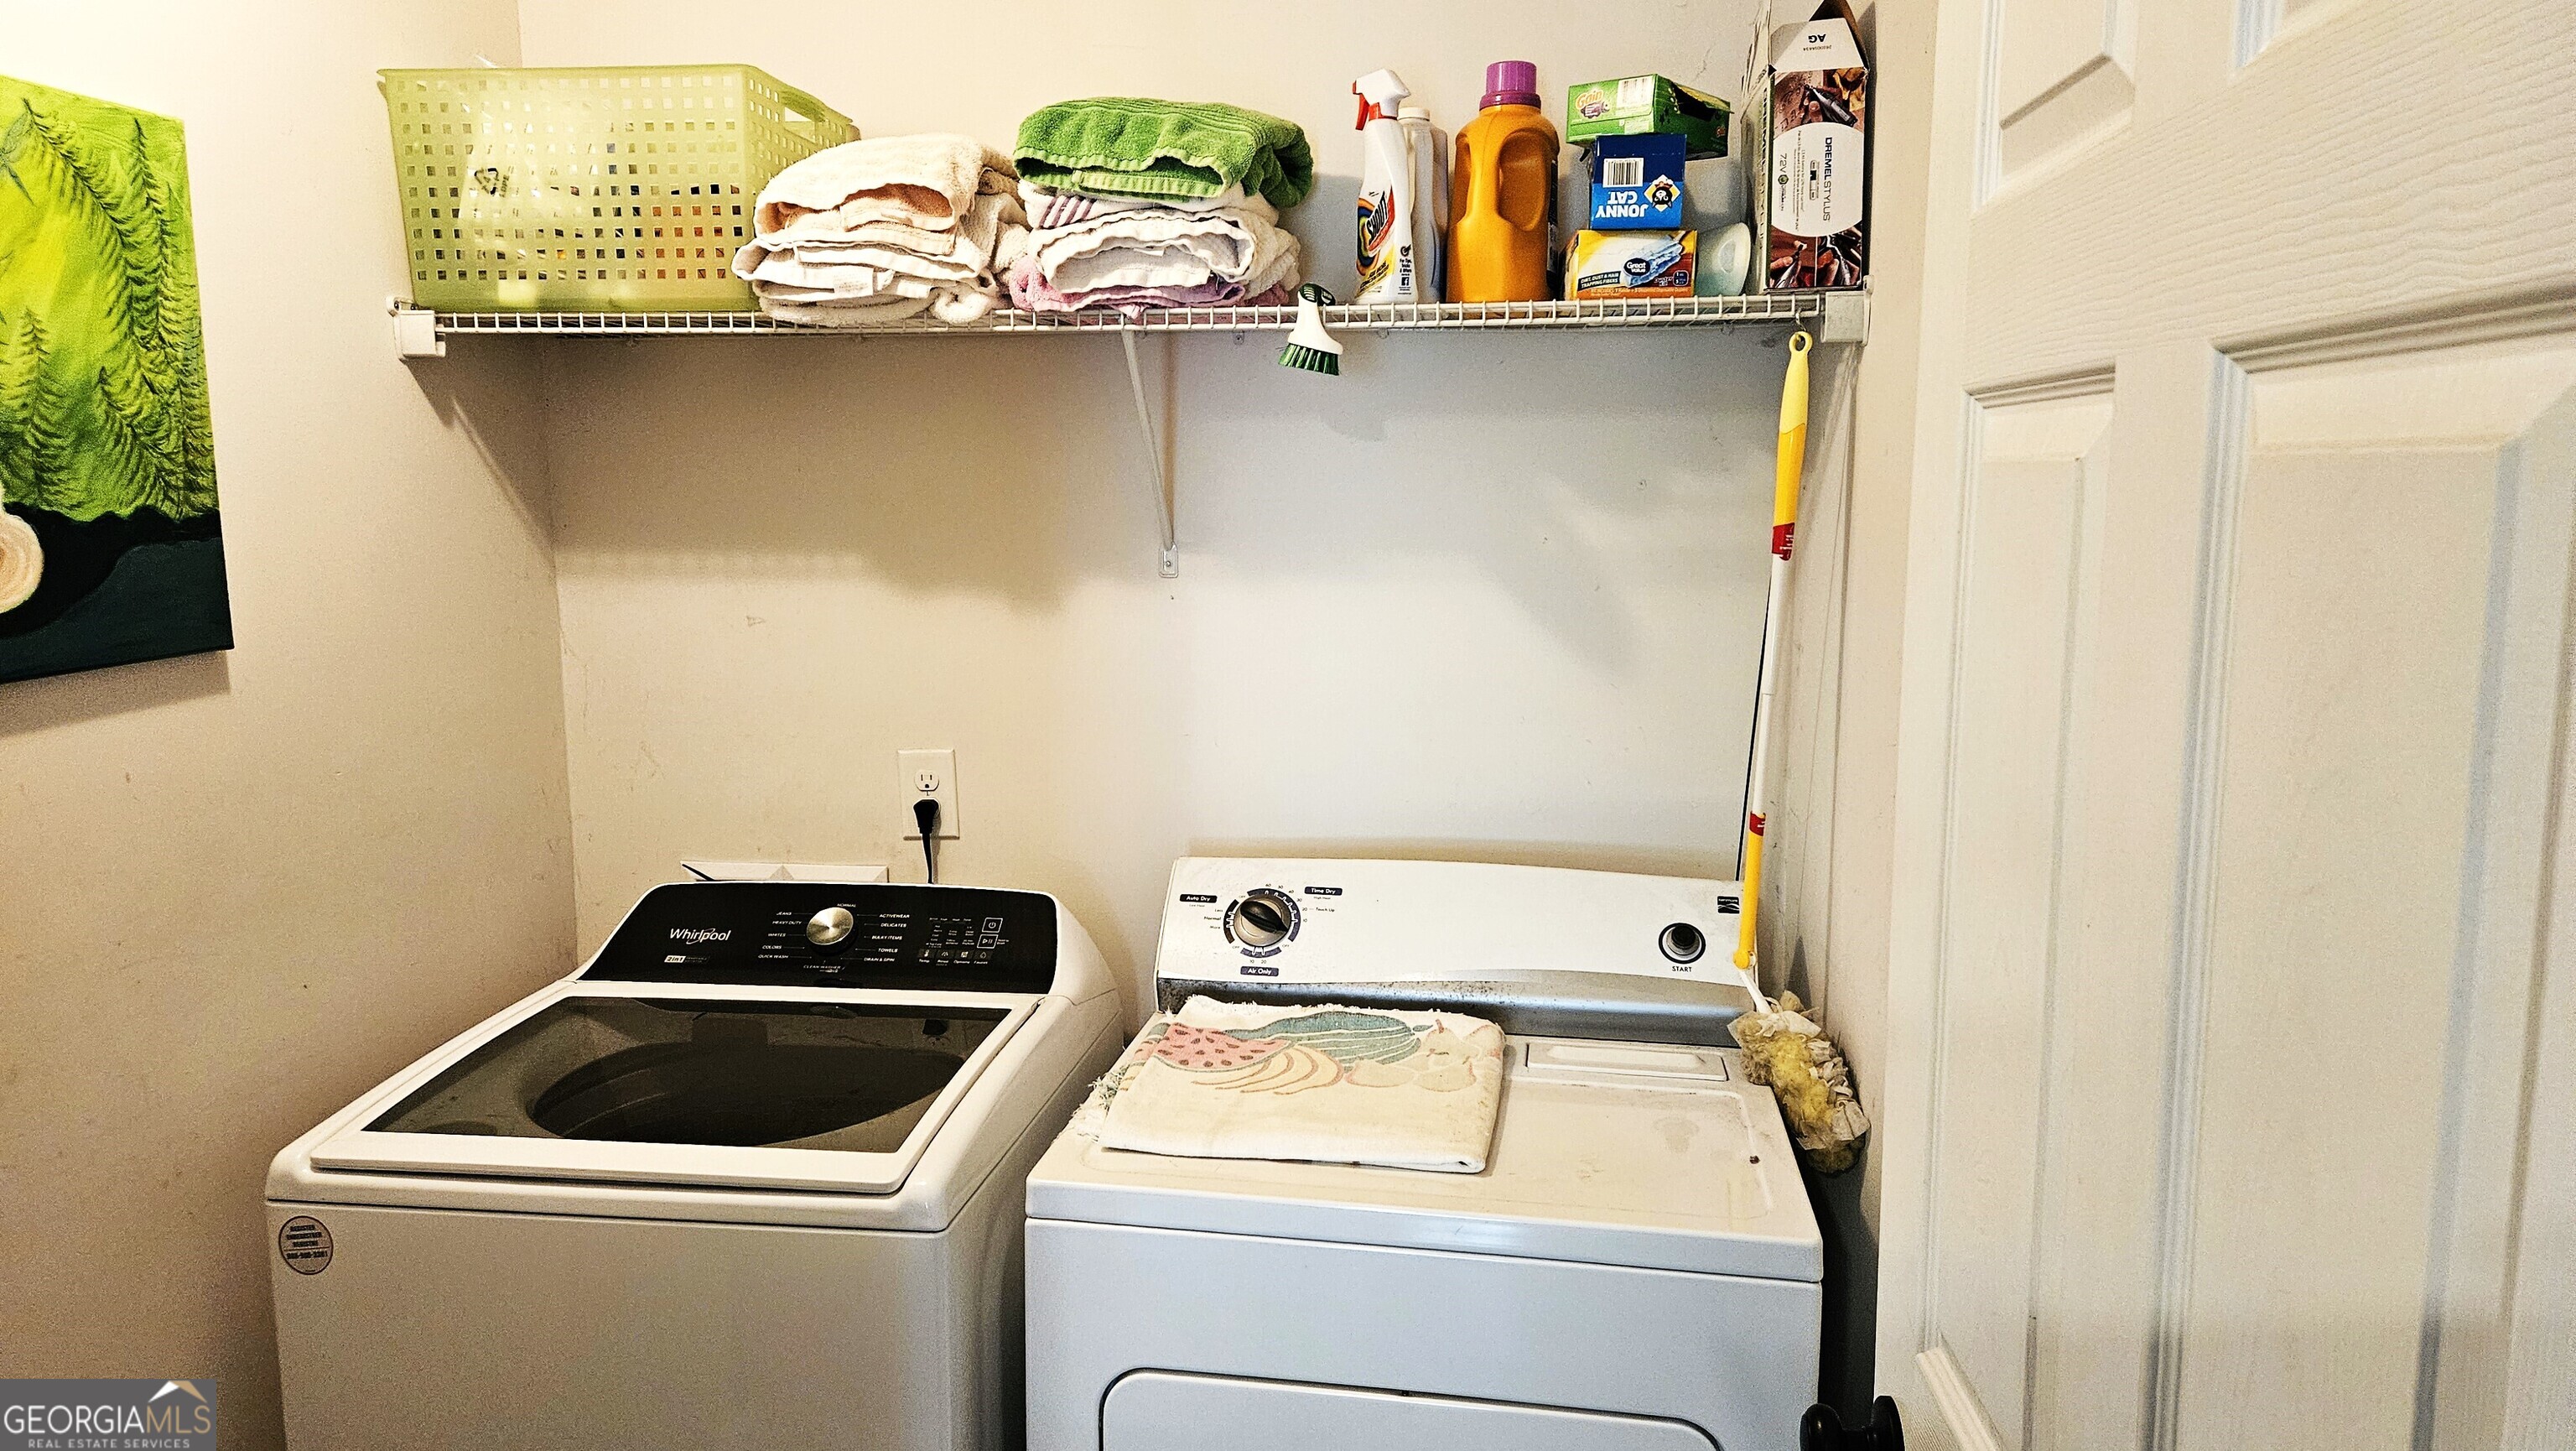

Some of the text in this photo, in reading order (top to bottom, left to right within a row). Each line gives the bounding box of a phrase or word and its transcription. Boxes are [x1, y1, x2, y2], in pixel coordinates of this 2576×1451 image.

[1808, 34, 1826, 44] AG
[1576, 89, 1604, 108] Gain
[1607, 191, 1639, 205] CAT
[1596, 204, 1649, 218] JONNY
[669, 928, 732, 944] Whirlpool
[1258, 967, 1272, 975] Only
